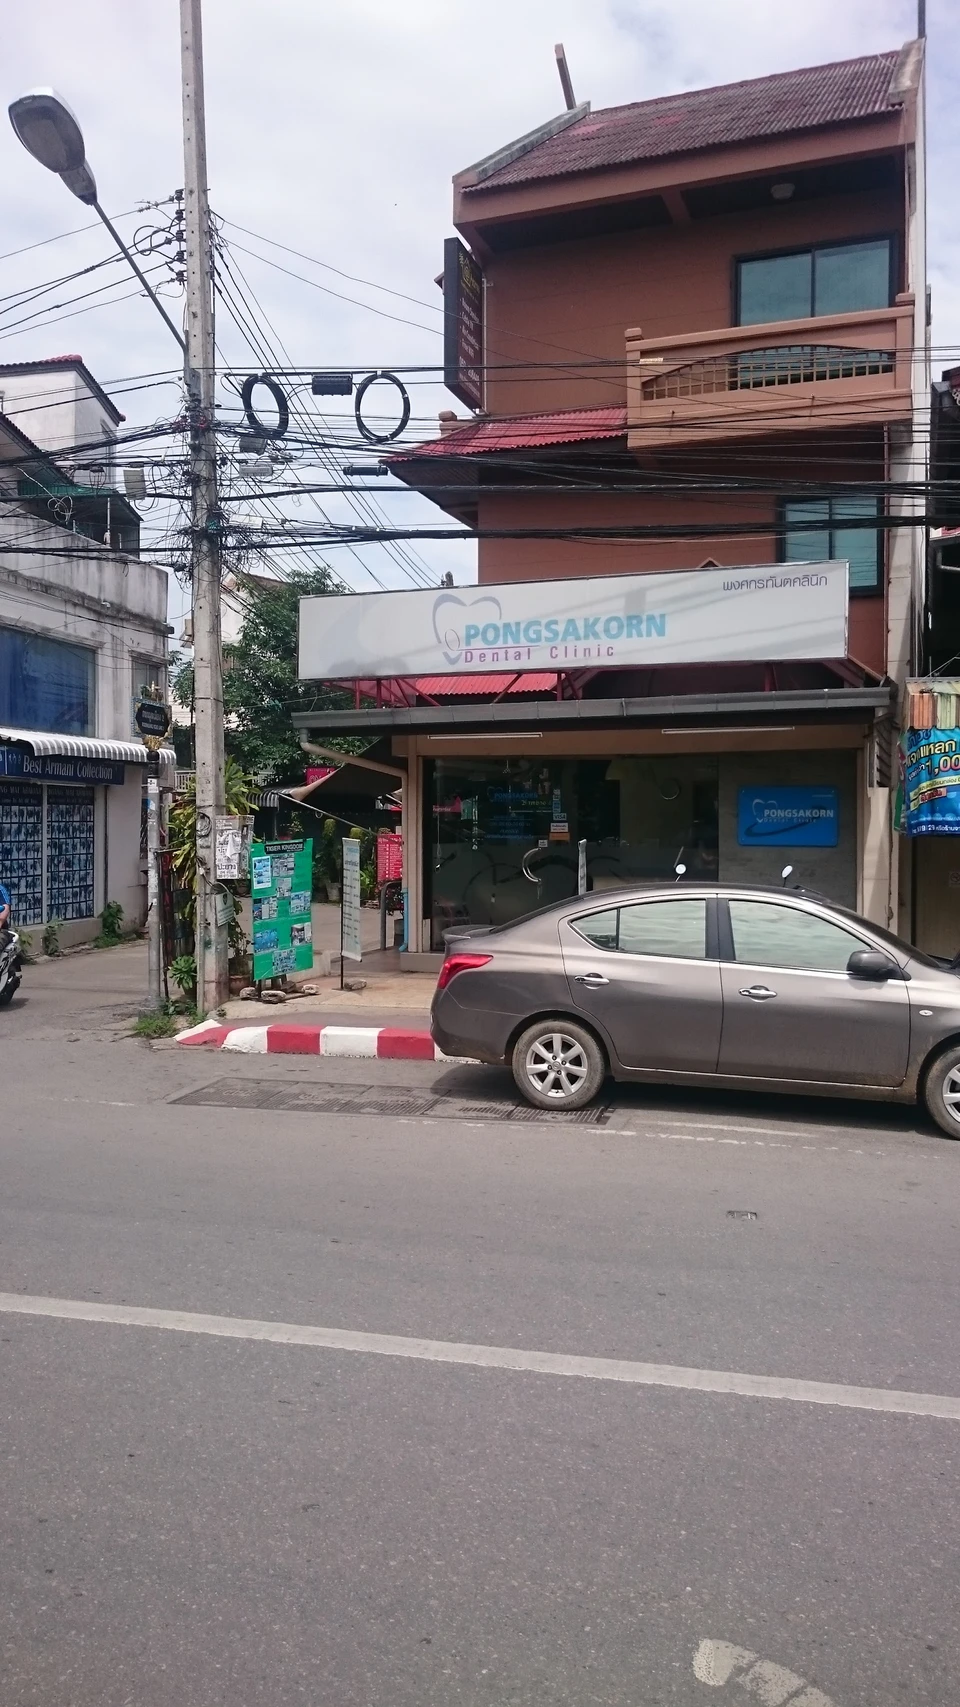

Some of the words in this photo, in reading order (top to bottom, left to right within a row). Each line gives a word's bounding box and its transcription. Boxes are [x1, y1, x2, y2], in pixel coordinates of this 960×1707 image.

[722, 574, 829, 591] พงศกรทันตคลินิก
[464, 613, 667, 647] PONGSAKORN
[464, 648, 532, 663] Dental
[550, 644, 614, 659] Clinic
[23, 755, 42, 774] Best
[45, 759, 74, 776] Armani
[76, 761, 113, 780] Collection
[763, 809, 834, 818] PONGSAKORN
[281, 842, 302, 850] KINGDOM
